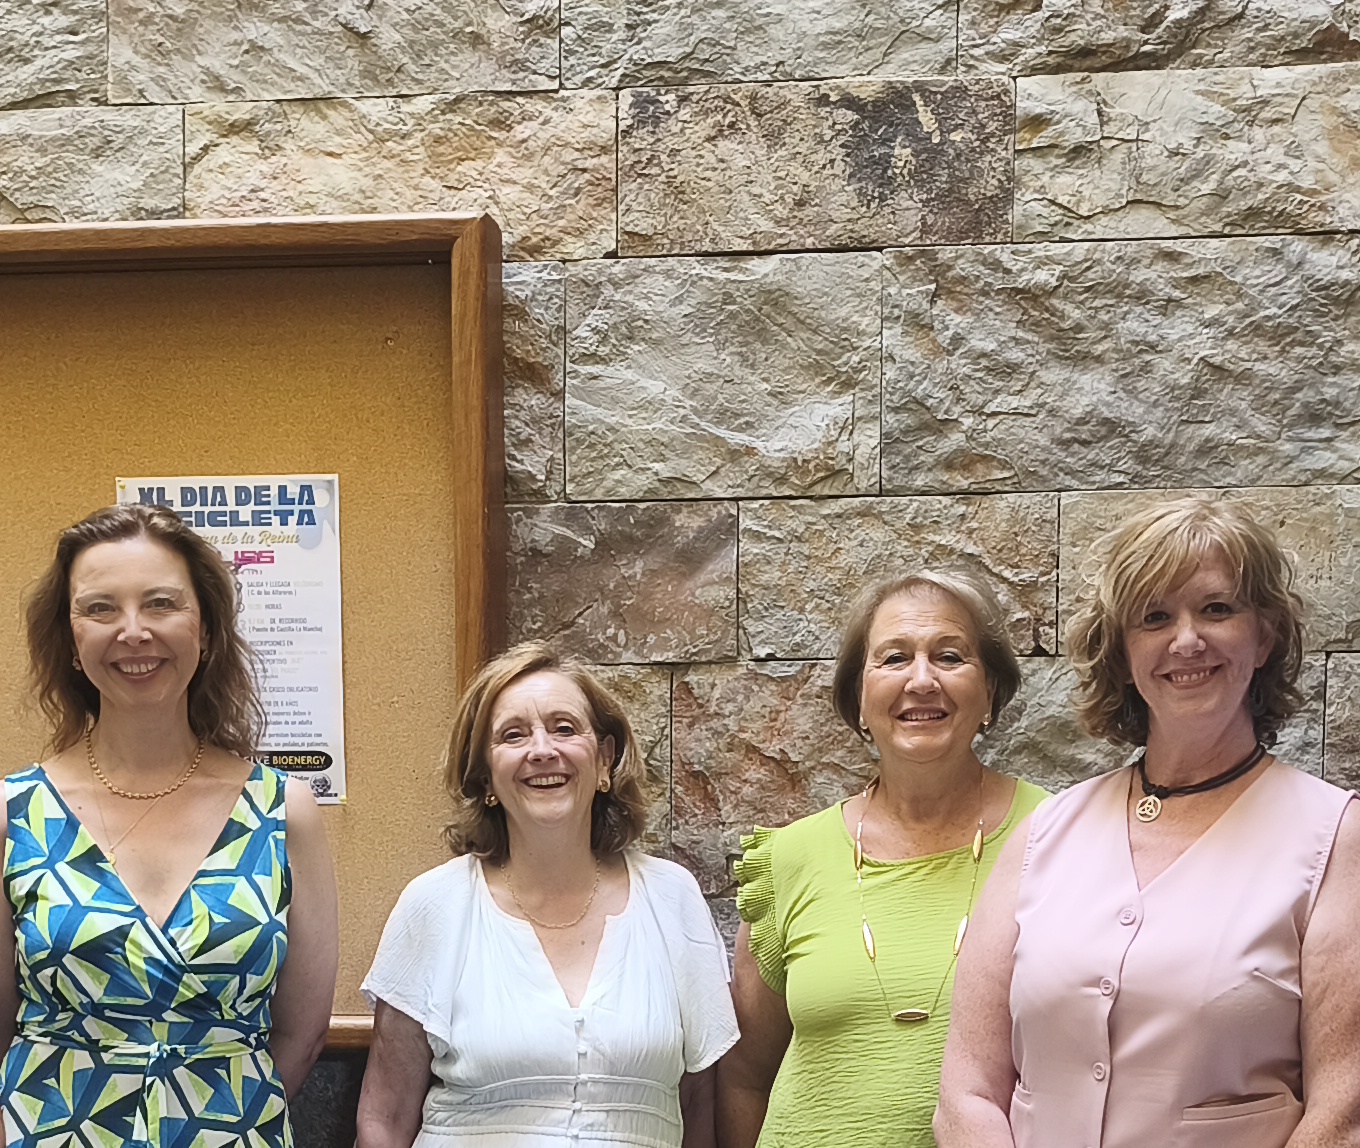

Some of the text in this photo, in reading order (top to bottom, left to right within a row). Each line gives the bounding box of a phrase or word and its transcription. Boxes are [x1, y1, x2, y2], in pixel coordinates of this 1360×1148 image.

[180, 486, 228, 507] DIA
[234, 485, 271, 506] DE
[277, 484, 316, 505] LA
[177, 509, 317, 527] CICLETA
[258, 530, 301, 547] Reina
[272, 756, 326, 765] BIOENERGY
